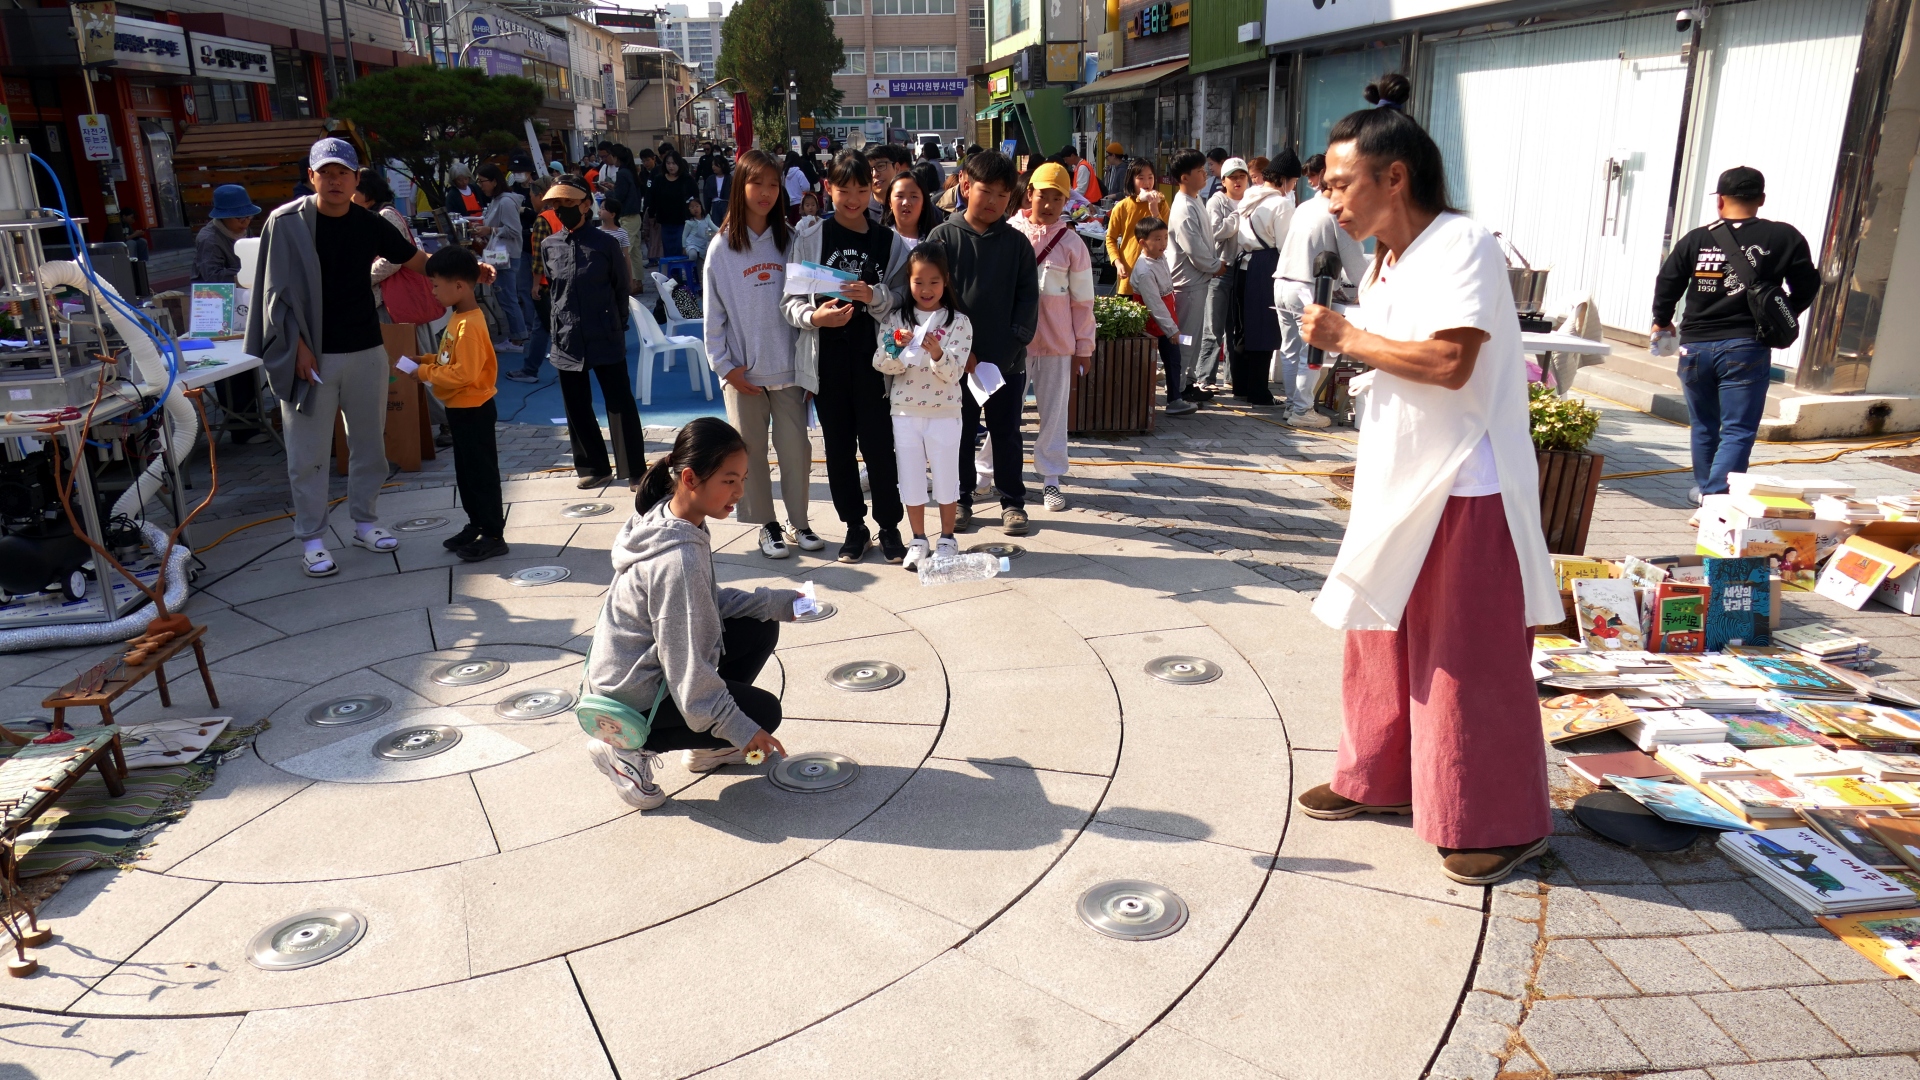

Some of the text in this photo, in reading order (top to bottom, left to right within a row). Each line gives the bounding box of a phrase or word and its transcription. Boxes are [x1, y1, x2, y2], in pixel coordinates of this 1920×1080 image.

[892, 81, 964, 92] 남원시자원봉사센터
[1698, 253, 1727, 262] DYN
[743, 262, 783, 278] FANTASTIC
[1695, 263, 1722, 271] FIT
[1723, 585, 1752, 598] 세상의
[1723, 599, 1752, 611] 낮과 밤
[1662, 613, 1700, 628] 독서치료
[623, 765, 634, 776] FILA
